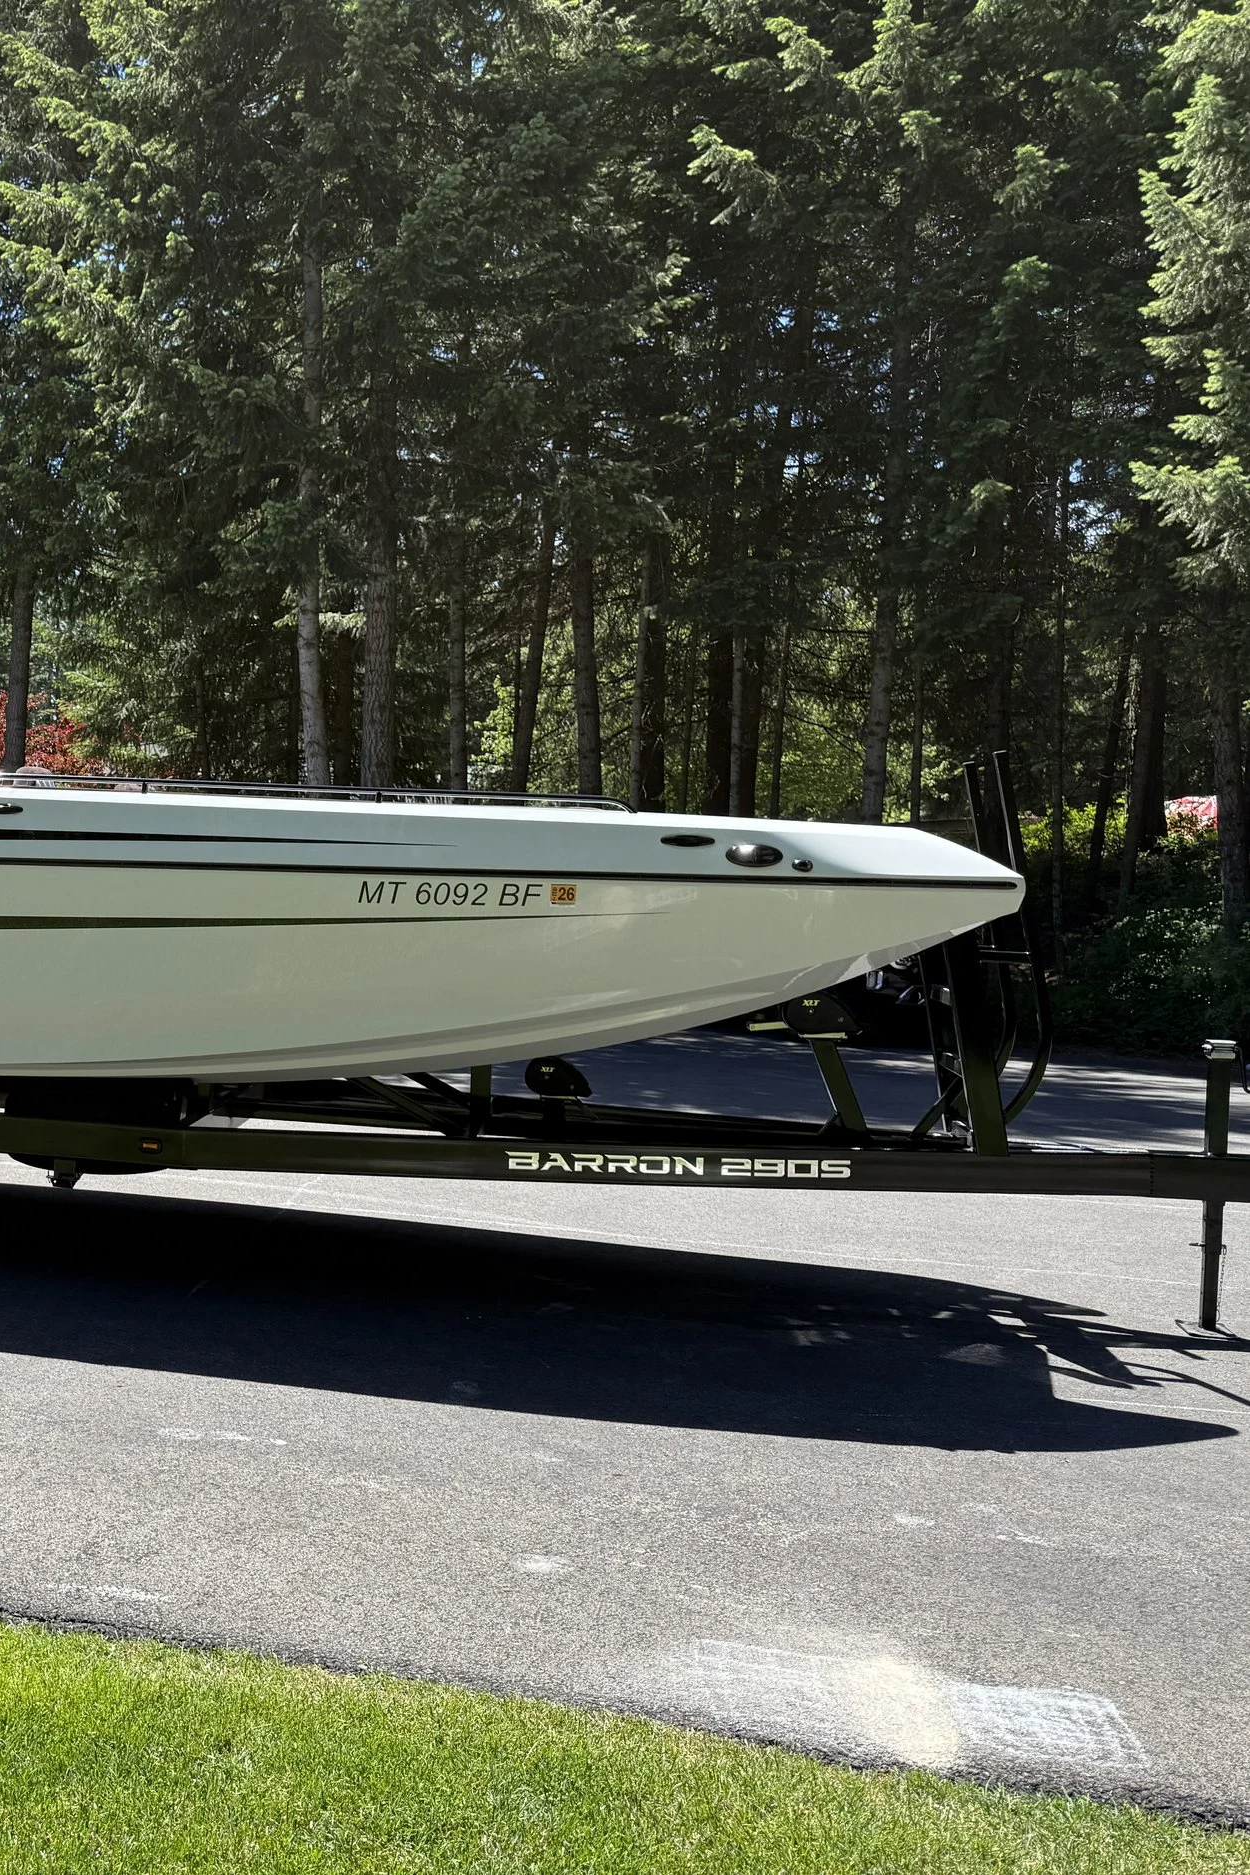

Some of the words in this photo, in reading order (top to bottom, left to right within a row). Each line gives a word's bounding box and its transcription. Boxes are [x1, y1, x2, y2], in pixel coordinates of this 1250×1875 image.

[358, 881, 407, 904] MT
[415, 882, 489, 906] 6092
[498, 883, 543, 907] BF
[558, 886, 575, 901] 26
[801, 999, 821, 1007] XLT
[504, 1150, 704, 1176] BARRON
[720, 1157, 851, 1179] 290S
